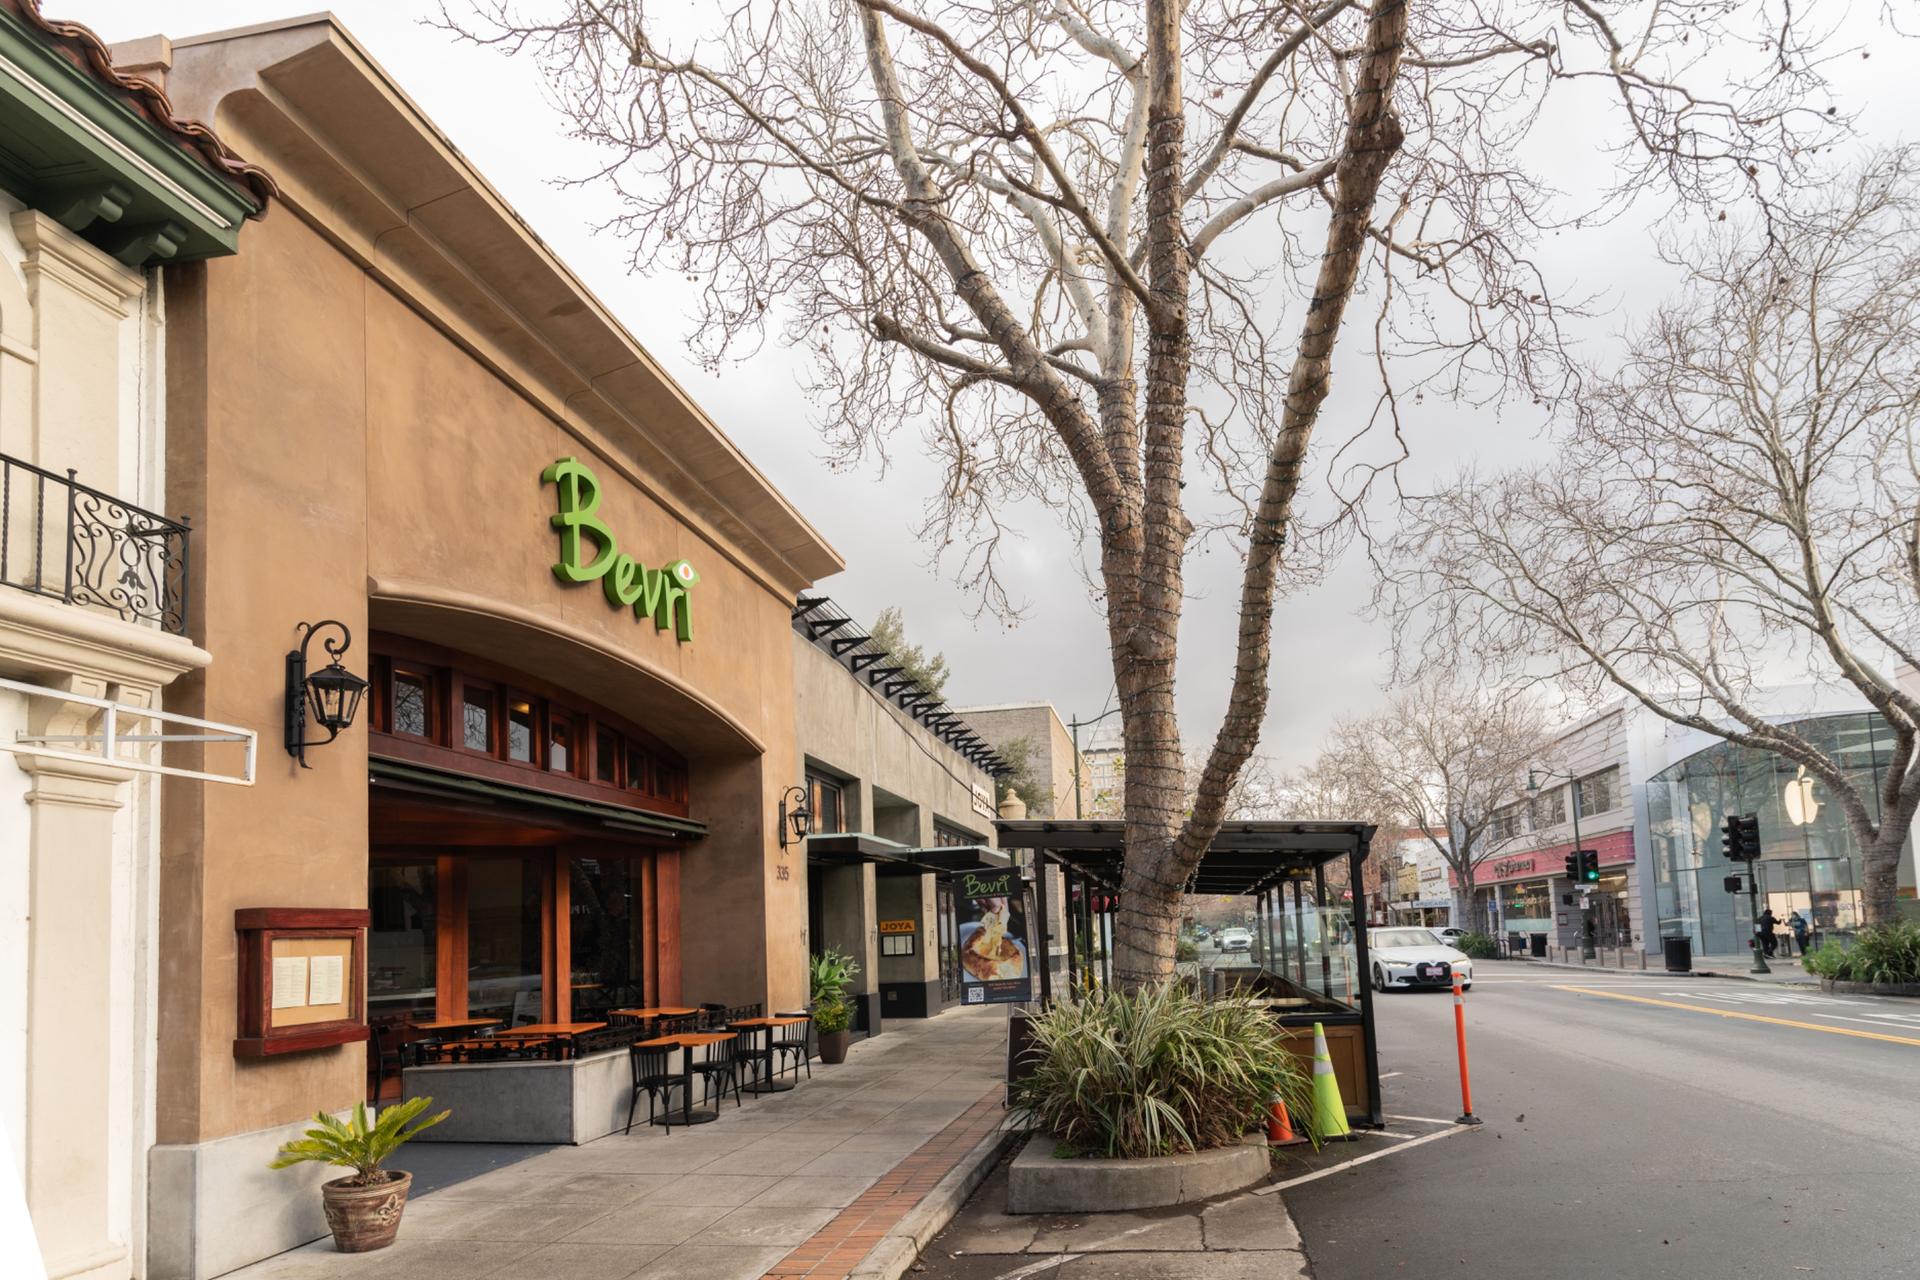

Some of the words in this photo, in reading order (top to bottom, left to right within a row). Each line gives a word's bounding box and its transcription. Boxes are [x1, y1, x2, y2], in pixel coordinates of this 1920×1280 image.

[542, 456, 700, 641] Bevri
[776, 864, 790, 881] 335
[962, 873, 1010, 896] Bevri
[882, 922, 913, 931] JOYA
